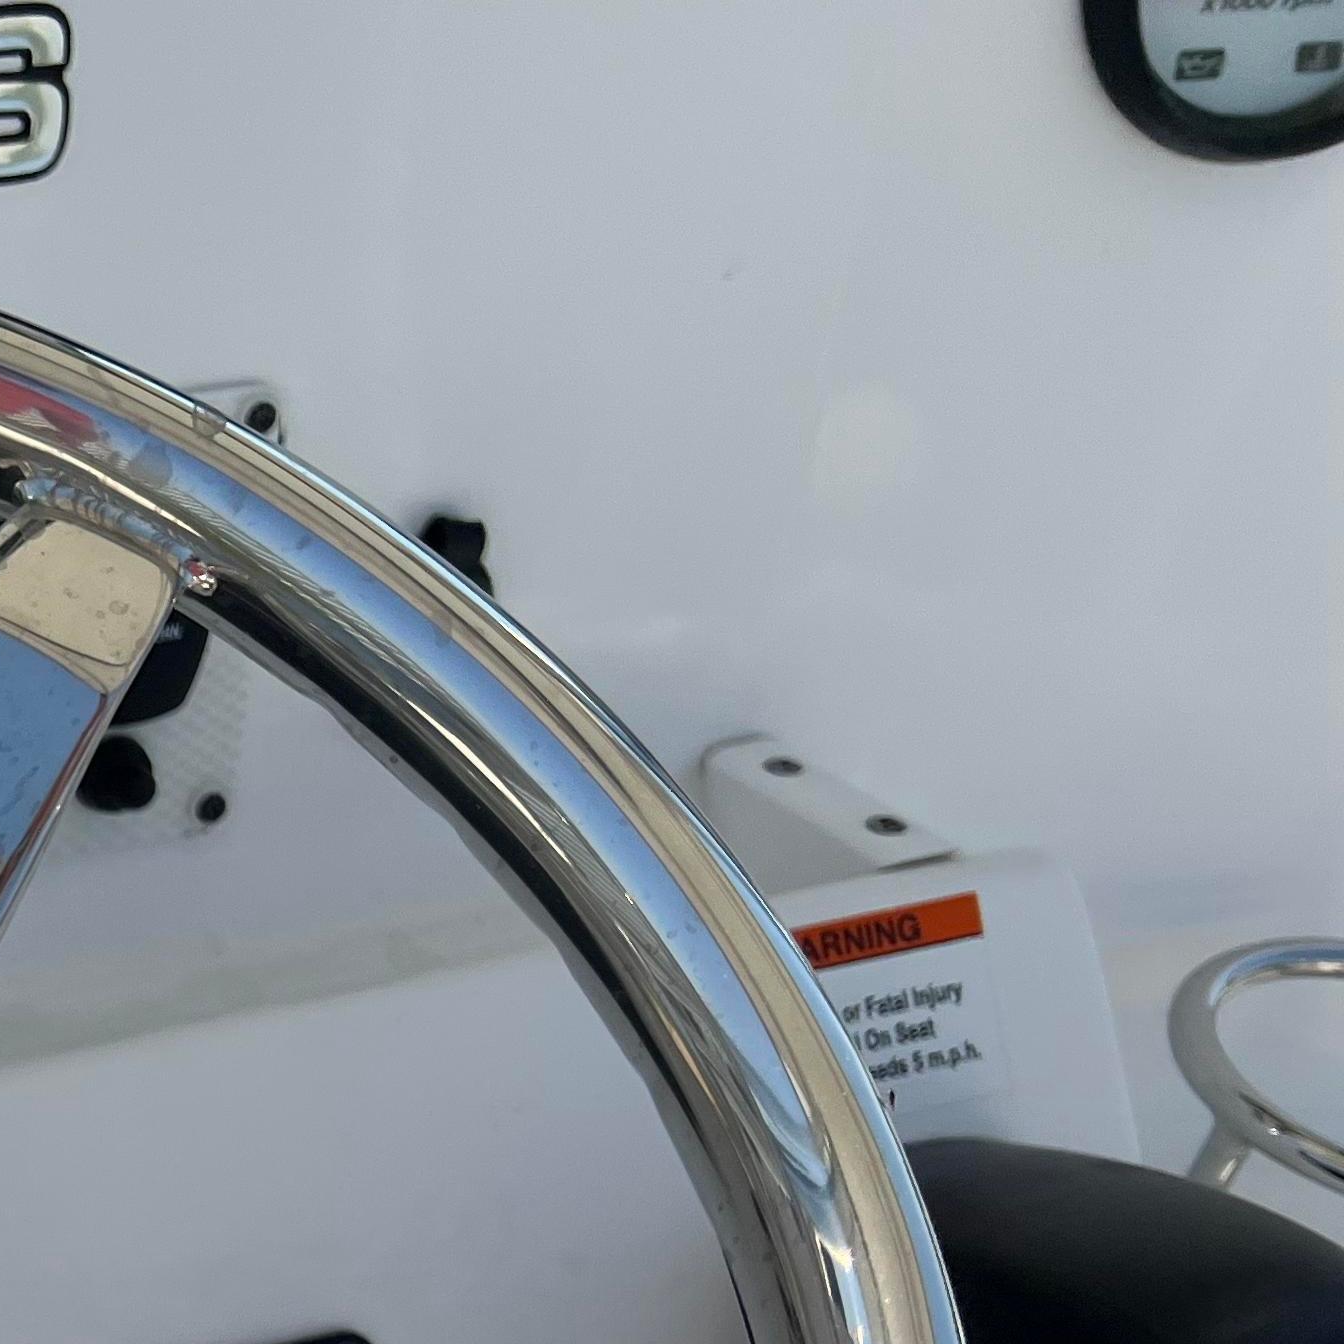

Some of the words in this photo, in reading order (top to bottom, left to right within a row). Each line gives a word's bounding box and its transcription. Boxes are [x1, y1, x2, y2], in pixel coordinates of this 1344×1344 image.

[800, 914, 923, 963] ARNING
[864, 989, 910, 1018] Fatal
[913, 982, 963, 1011] Injury
[864, 1027, 892, 1051] On
[894, 1018, 937, 1044] Seat
[913, 1052, 925, 1073] 5
[928, 1039, 983, 1069] m.p.h.
